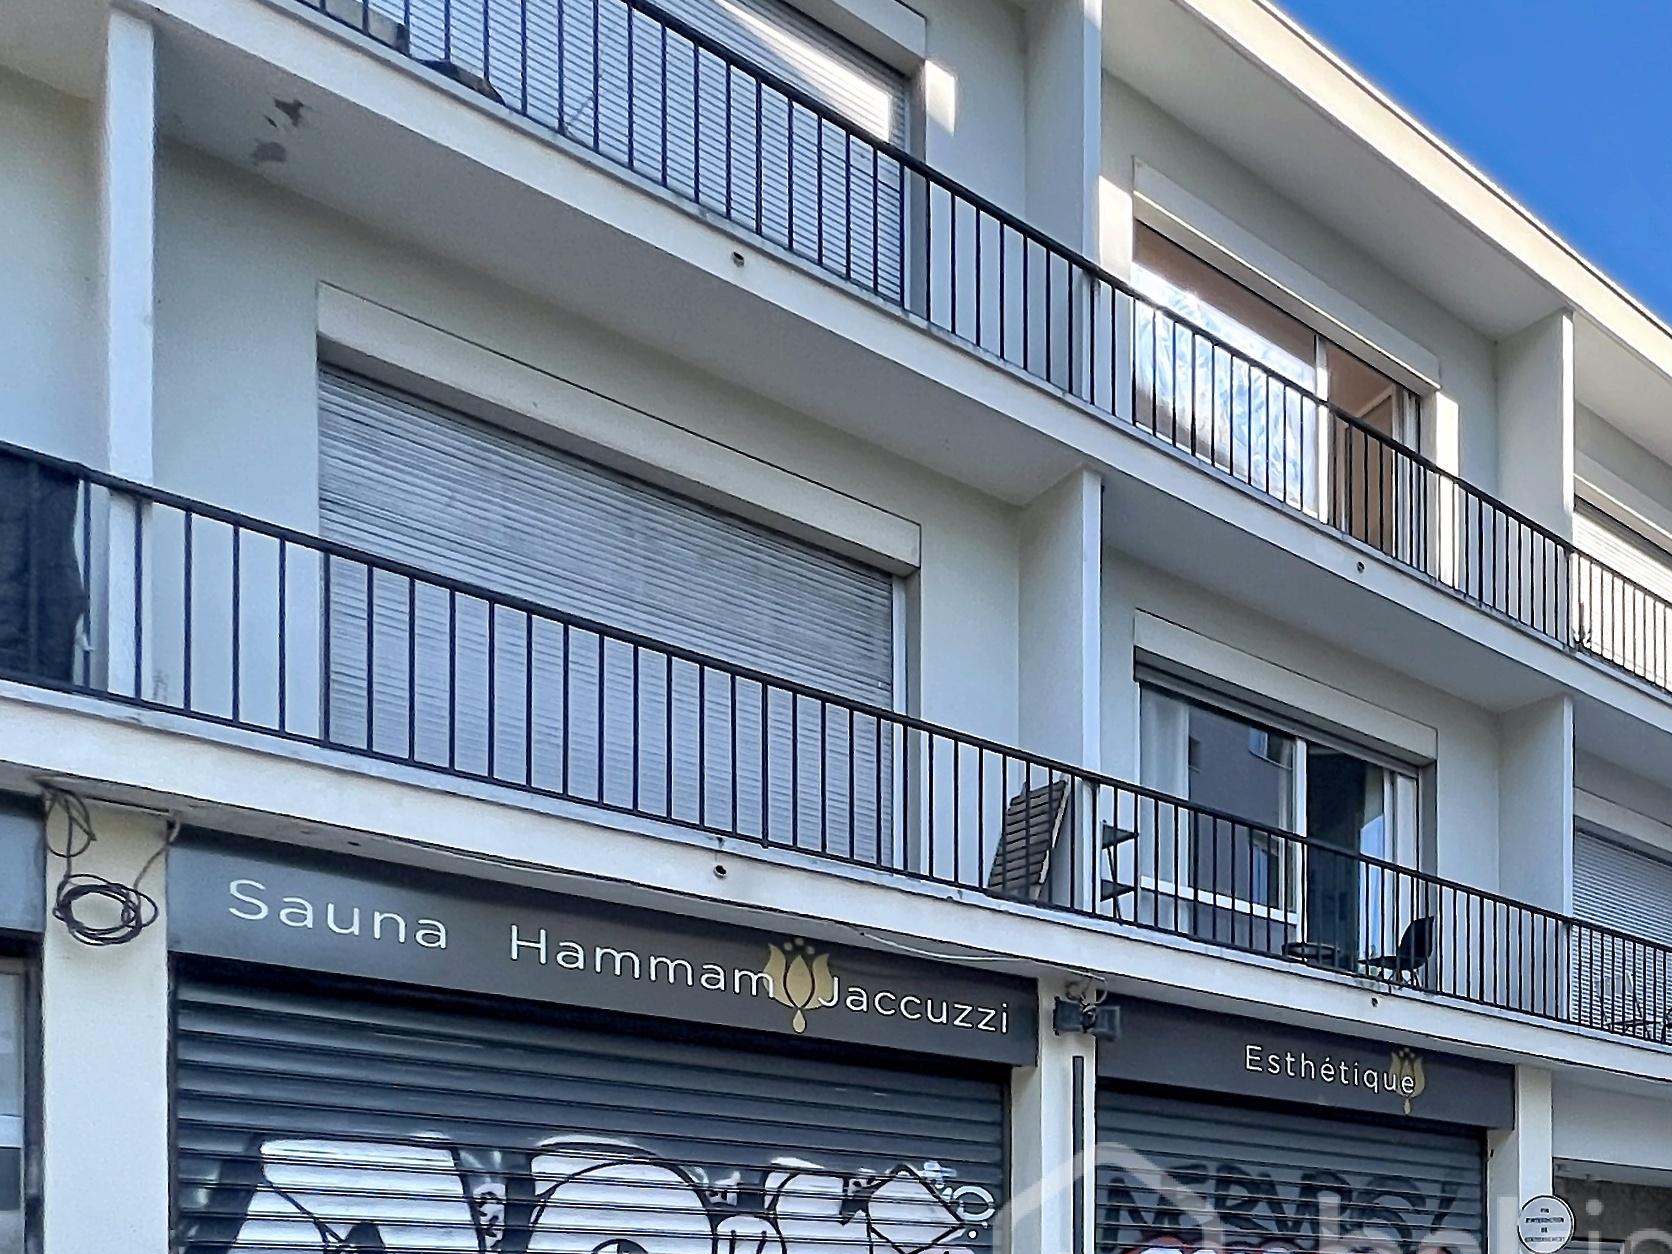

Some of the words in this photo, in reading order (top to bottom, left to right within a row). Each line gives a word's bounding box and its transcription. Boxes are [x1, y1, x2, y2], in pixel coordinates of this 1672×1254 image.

[227, 878, 449, 952] Sauna
[508, 924, 777, 1000] Hammam
[817, 974, 1011, 1035] Jaccuzzi
[1244, 1044, 1416, 1096] Esthétique
